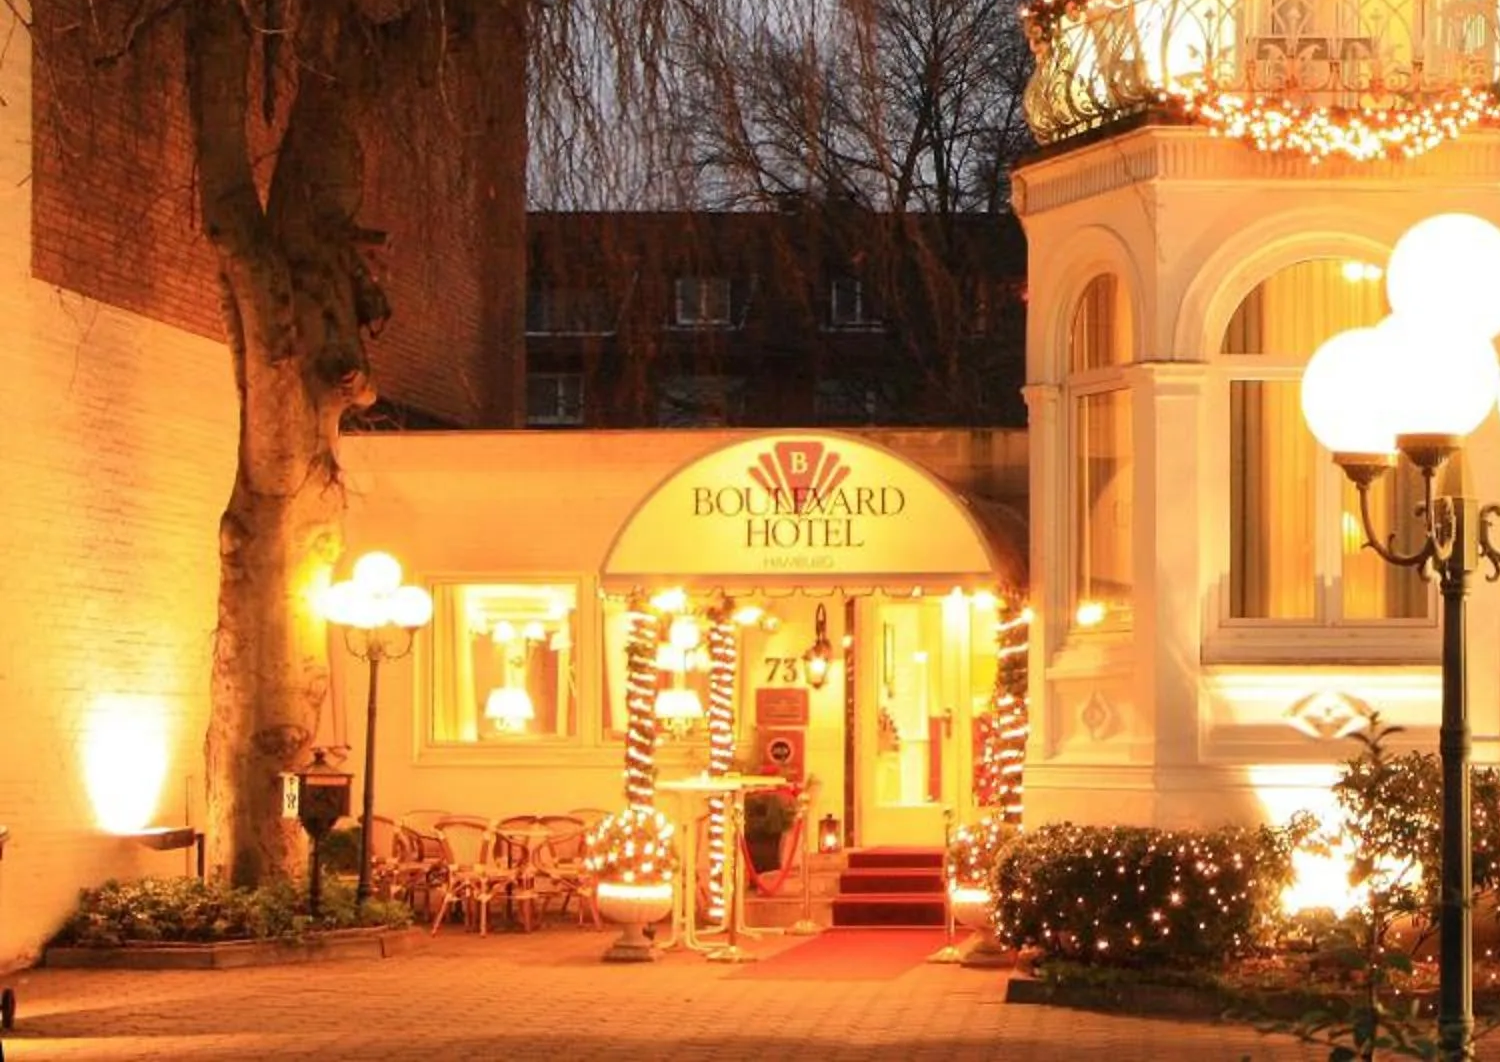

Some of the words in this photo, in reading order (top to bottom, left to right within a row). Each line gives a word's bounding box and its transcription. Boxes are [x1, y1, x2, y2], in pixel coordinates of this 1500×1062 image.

[790, 451, 809, 474] B
[692, 486, 906, 517] BOULEVARD
[746, 517, 865, 548] HOTEL
[764, 657, 798, 683] 73
